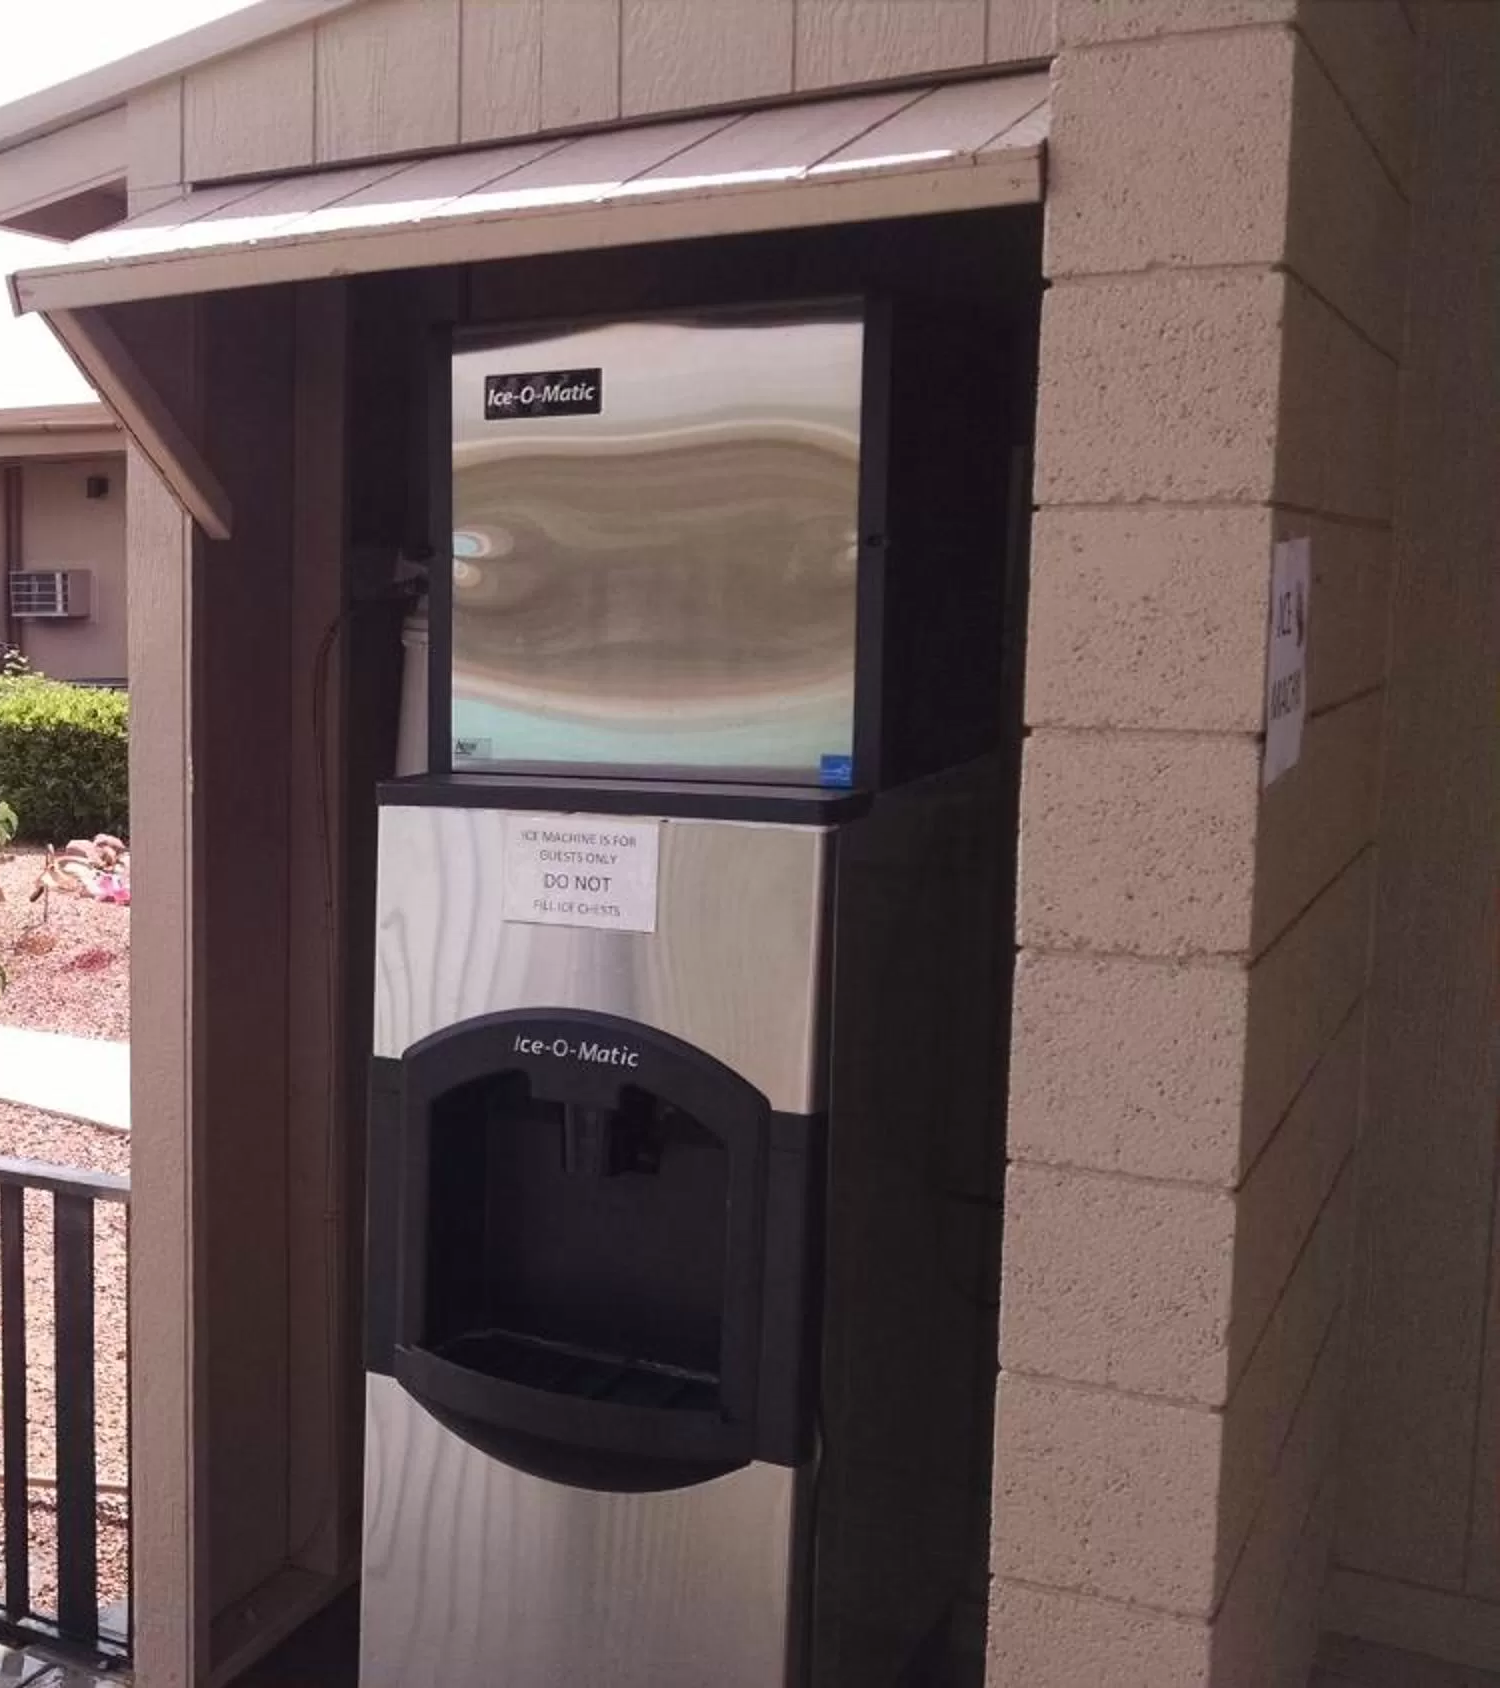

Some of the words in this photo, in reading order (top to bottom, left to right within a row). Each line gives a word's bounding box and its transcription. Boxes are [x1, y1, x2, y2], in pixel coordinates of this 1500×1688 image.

[487, 382, 596, 407] Ice-O-Matic
[521, 830, 539, 842] ICE
[542, 831, 597, 845] MACHINE
[600, 835, 611, 846] IS
[613, 835, 637, 848] FOR
[539, 849, 583, 864] GUESTS
[586, 852, 618, 865] ONLY
[543, 873, 569, 890] DO
[574, 876, 612, 892] NOT
[533, 899, 556, 912] FILL
[577, 903, 621, 917] CHESTS
[513, 1033, 639, 1067] Ice-O-Matic
